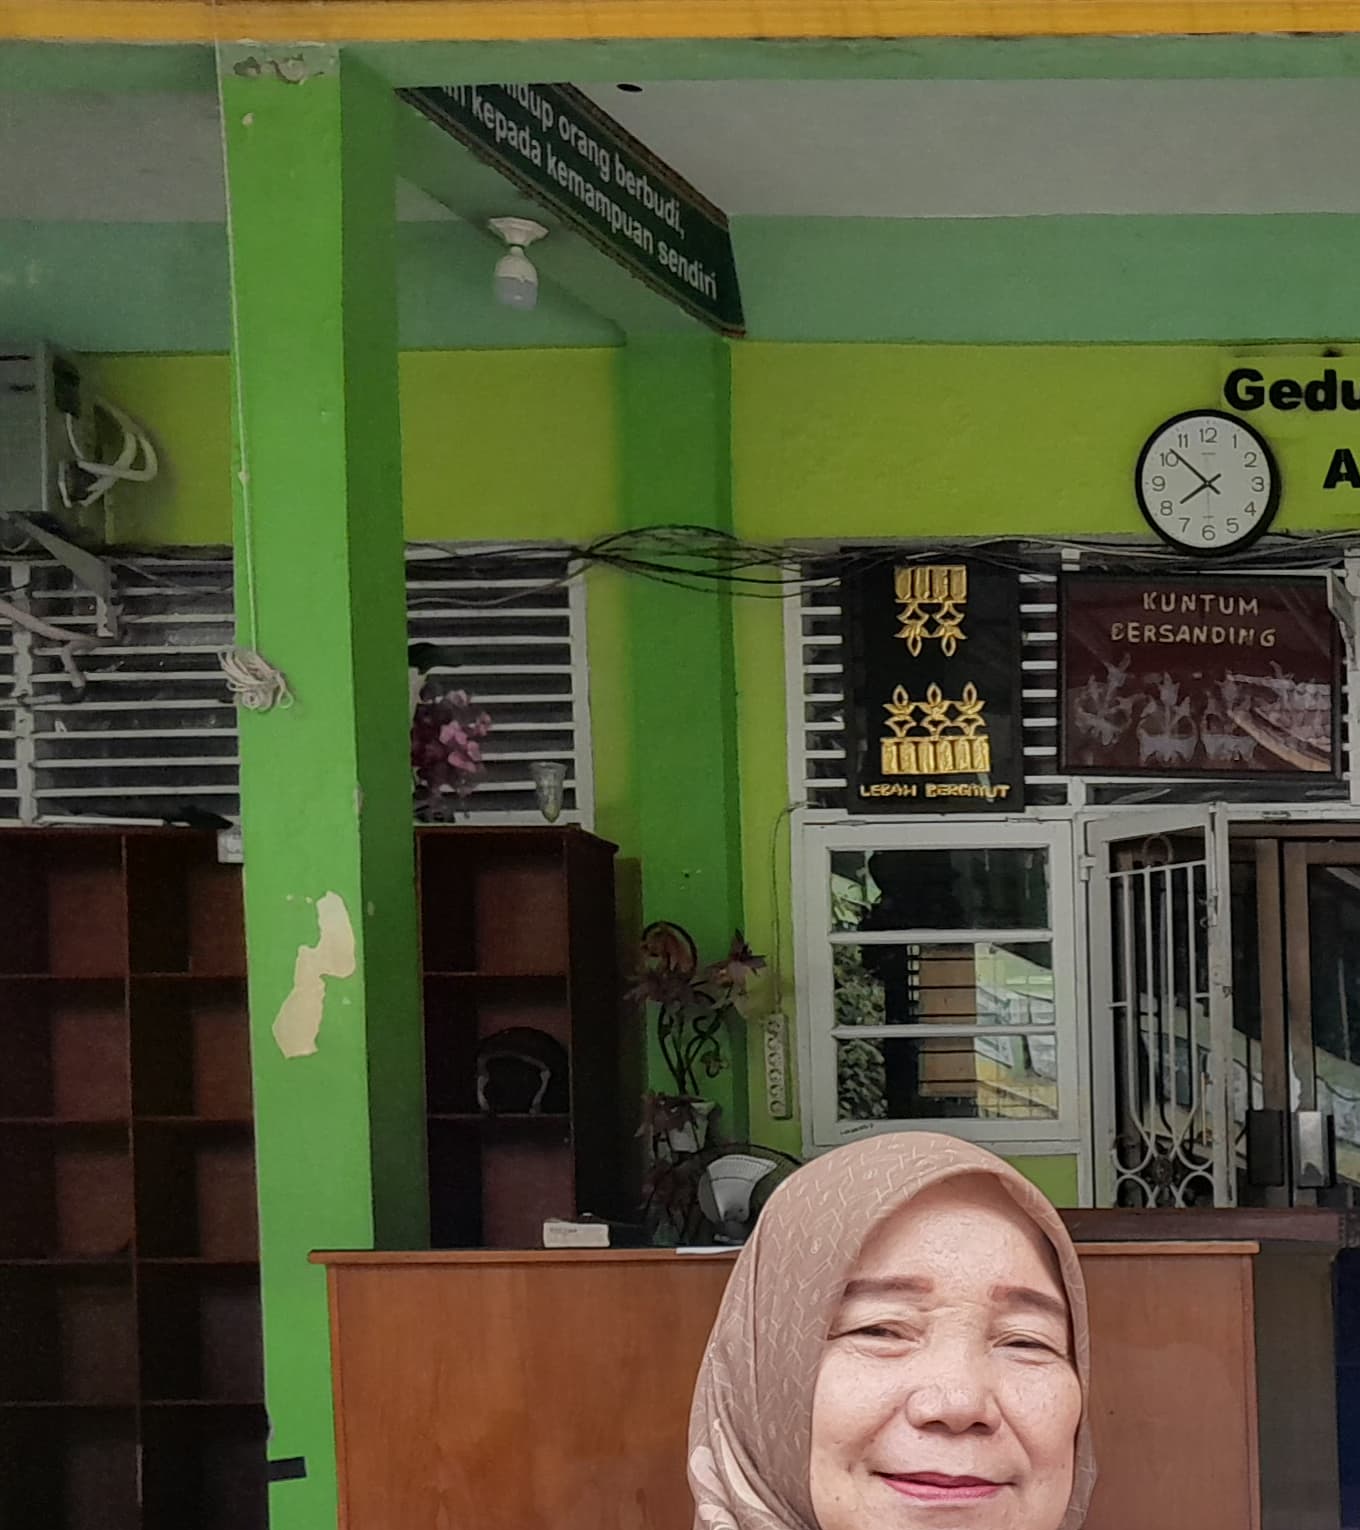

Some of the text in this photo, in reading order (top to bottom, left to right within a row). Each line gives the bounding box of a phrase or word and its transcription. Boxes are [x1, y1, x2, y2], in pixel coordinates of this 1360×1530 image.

[559, 115, 611, 182] orang
[614, 152, 686, 241] berbudi,
[471, 85, 717, 300] kepada kemampuan sendiri
[1178, 433, 1189, 448] 11
[1199, 427, 1218, 443] 12
[1160, 452, 1179, 467] 10
[1244, 452, 1257, 467] 2
[1151, 475, 1166, 491] 9
[1251, 476, 1265, 492] 3
[1160, 500, 1173, 515] 8
[1244, 501, 1257, 516] 4
[1178, 517, 1191, 532] 7
[1226, 518, 1239, 533] 5
[1201, 525, 1216, 540] 6
[1143, 592, 1259, 616] KUNTUM
[1111, 622, 1276, 647] BERSANDING
[860, 783, 917, 797] LEBAH
